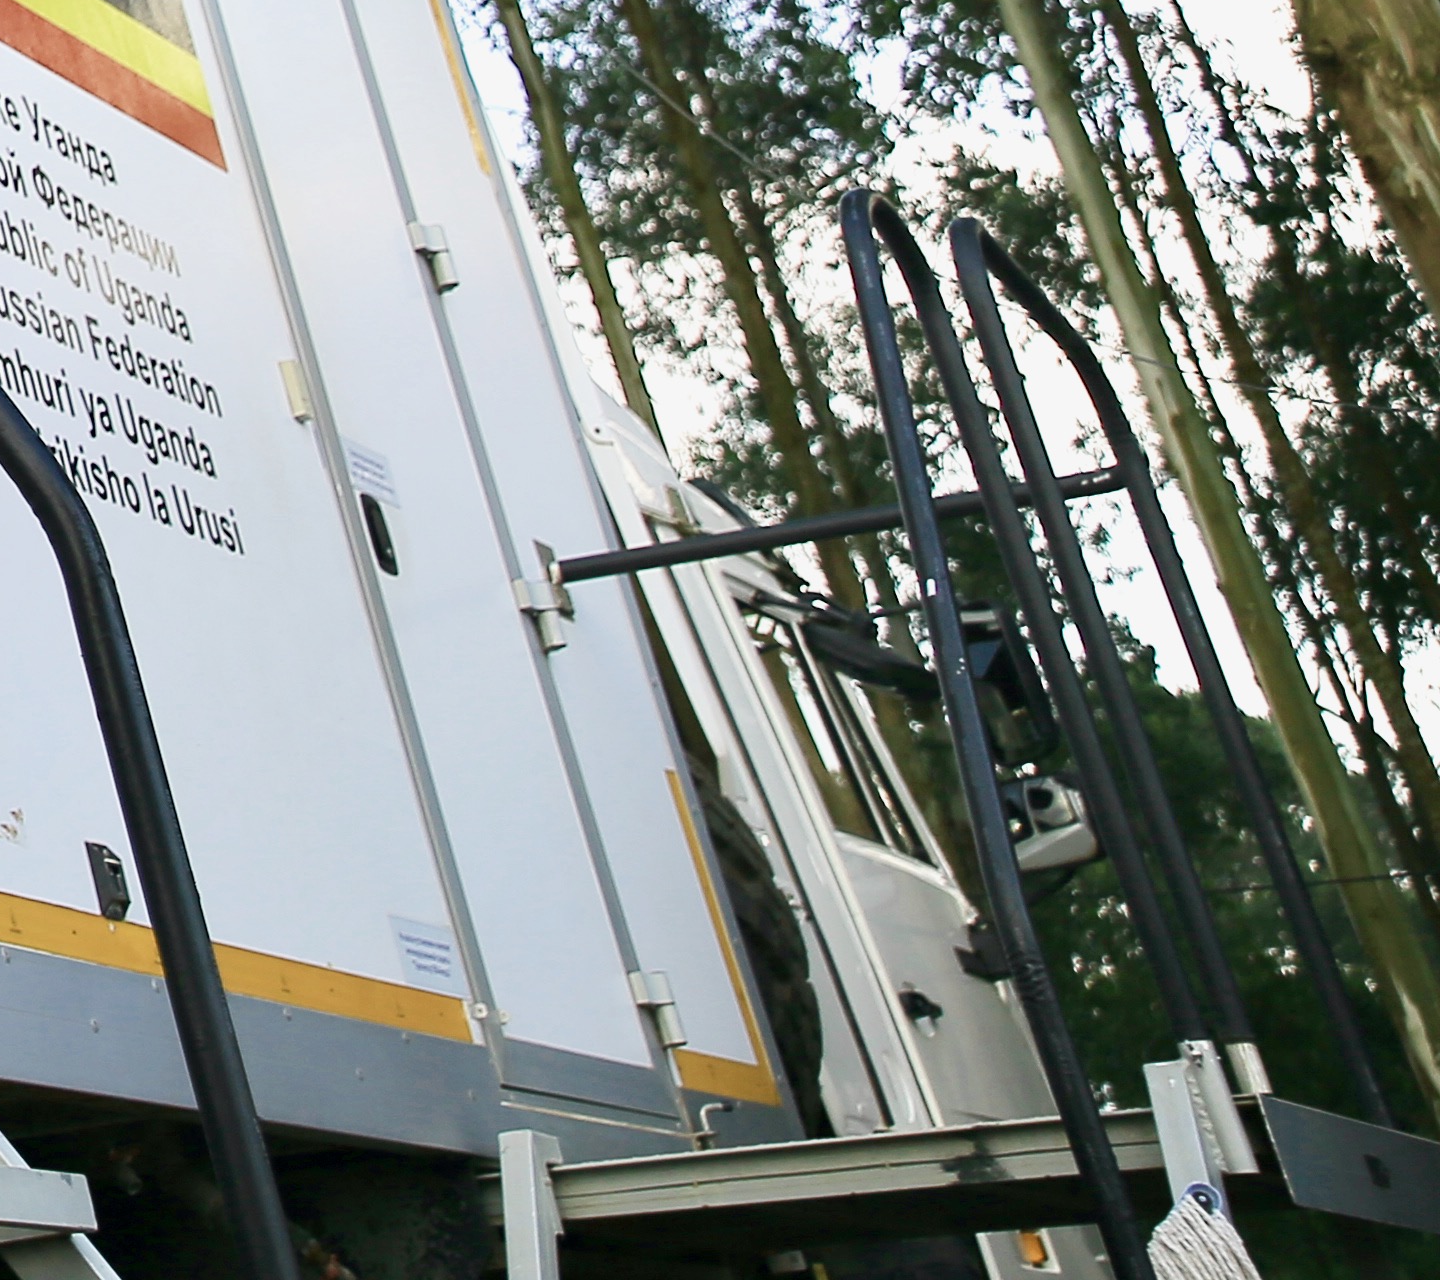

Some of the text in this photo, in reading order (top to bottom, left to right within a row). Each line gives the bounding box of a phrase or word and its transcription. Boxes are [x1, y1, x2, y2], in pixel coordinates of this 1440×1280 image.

[22, 95, 118, 186] Уганда
[32, 165, 181, 278] Федерации
[64, 247, 91, 292] of
[93, 255, 193, 344] Uganda
[85, 314, 223, 418] Federation
[78, 388, 116, 438] ya
[115, 393, 218, 479] Uganda
[142, 472, 173, 527] la
[171, 484, 245, 555] Urusi
